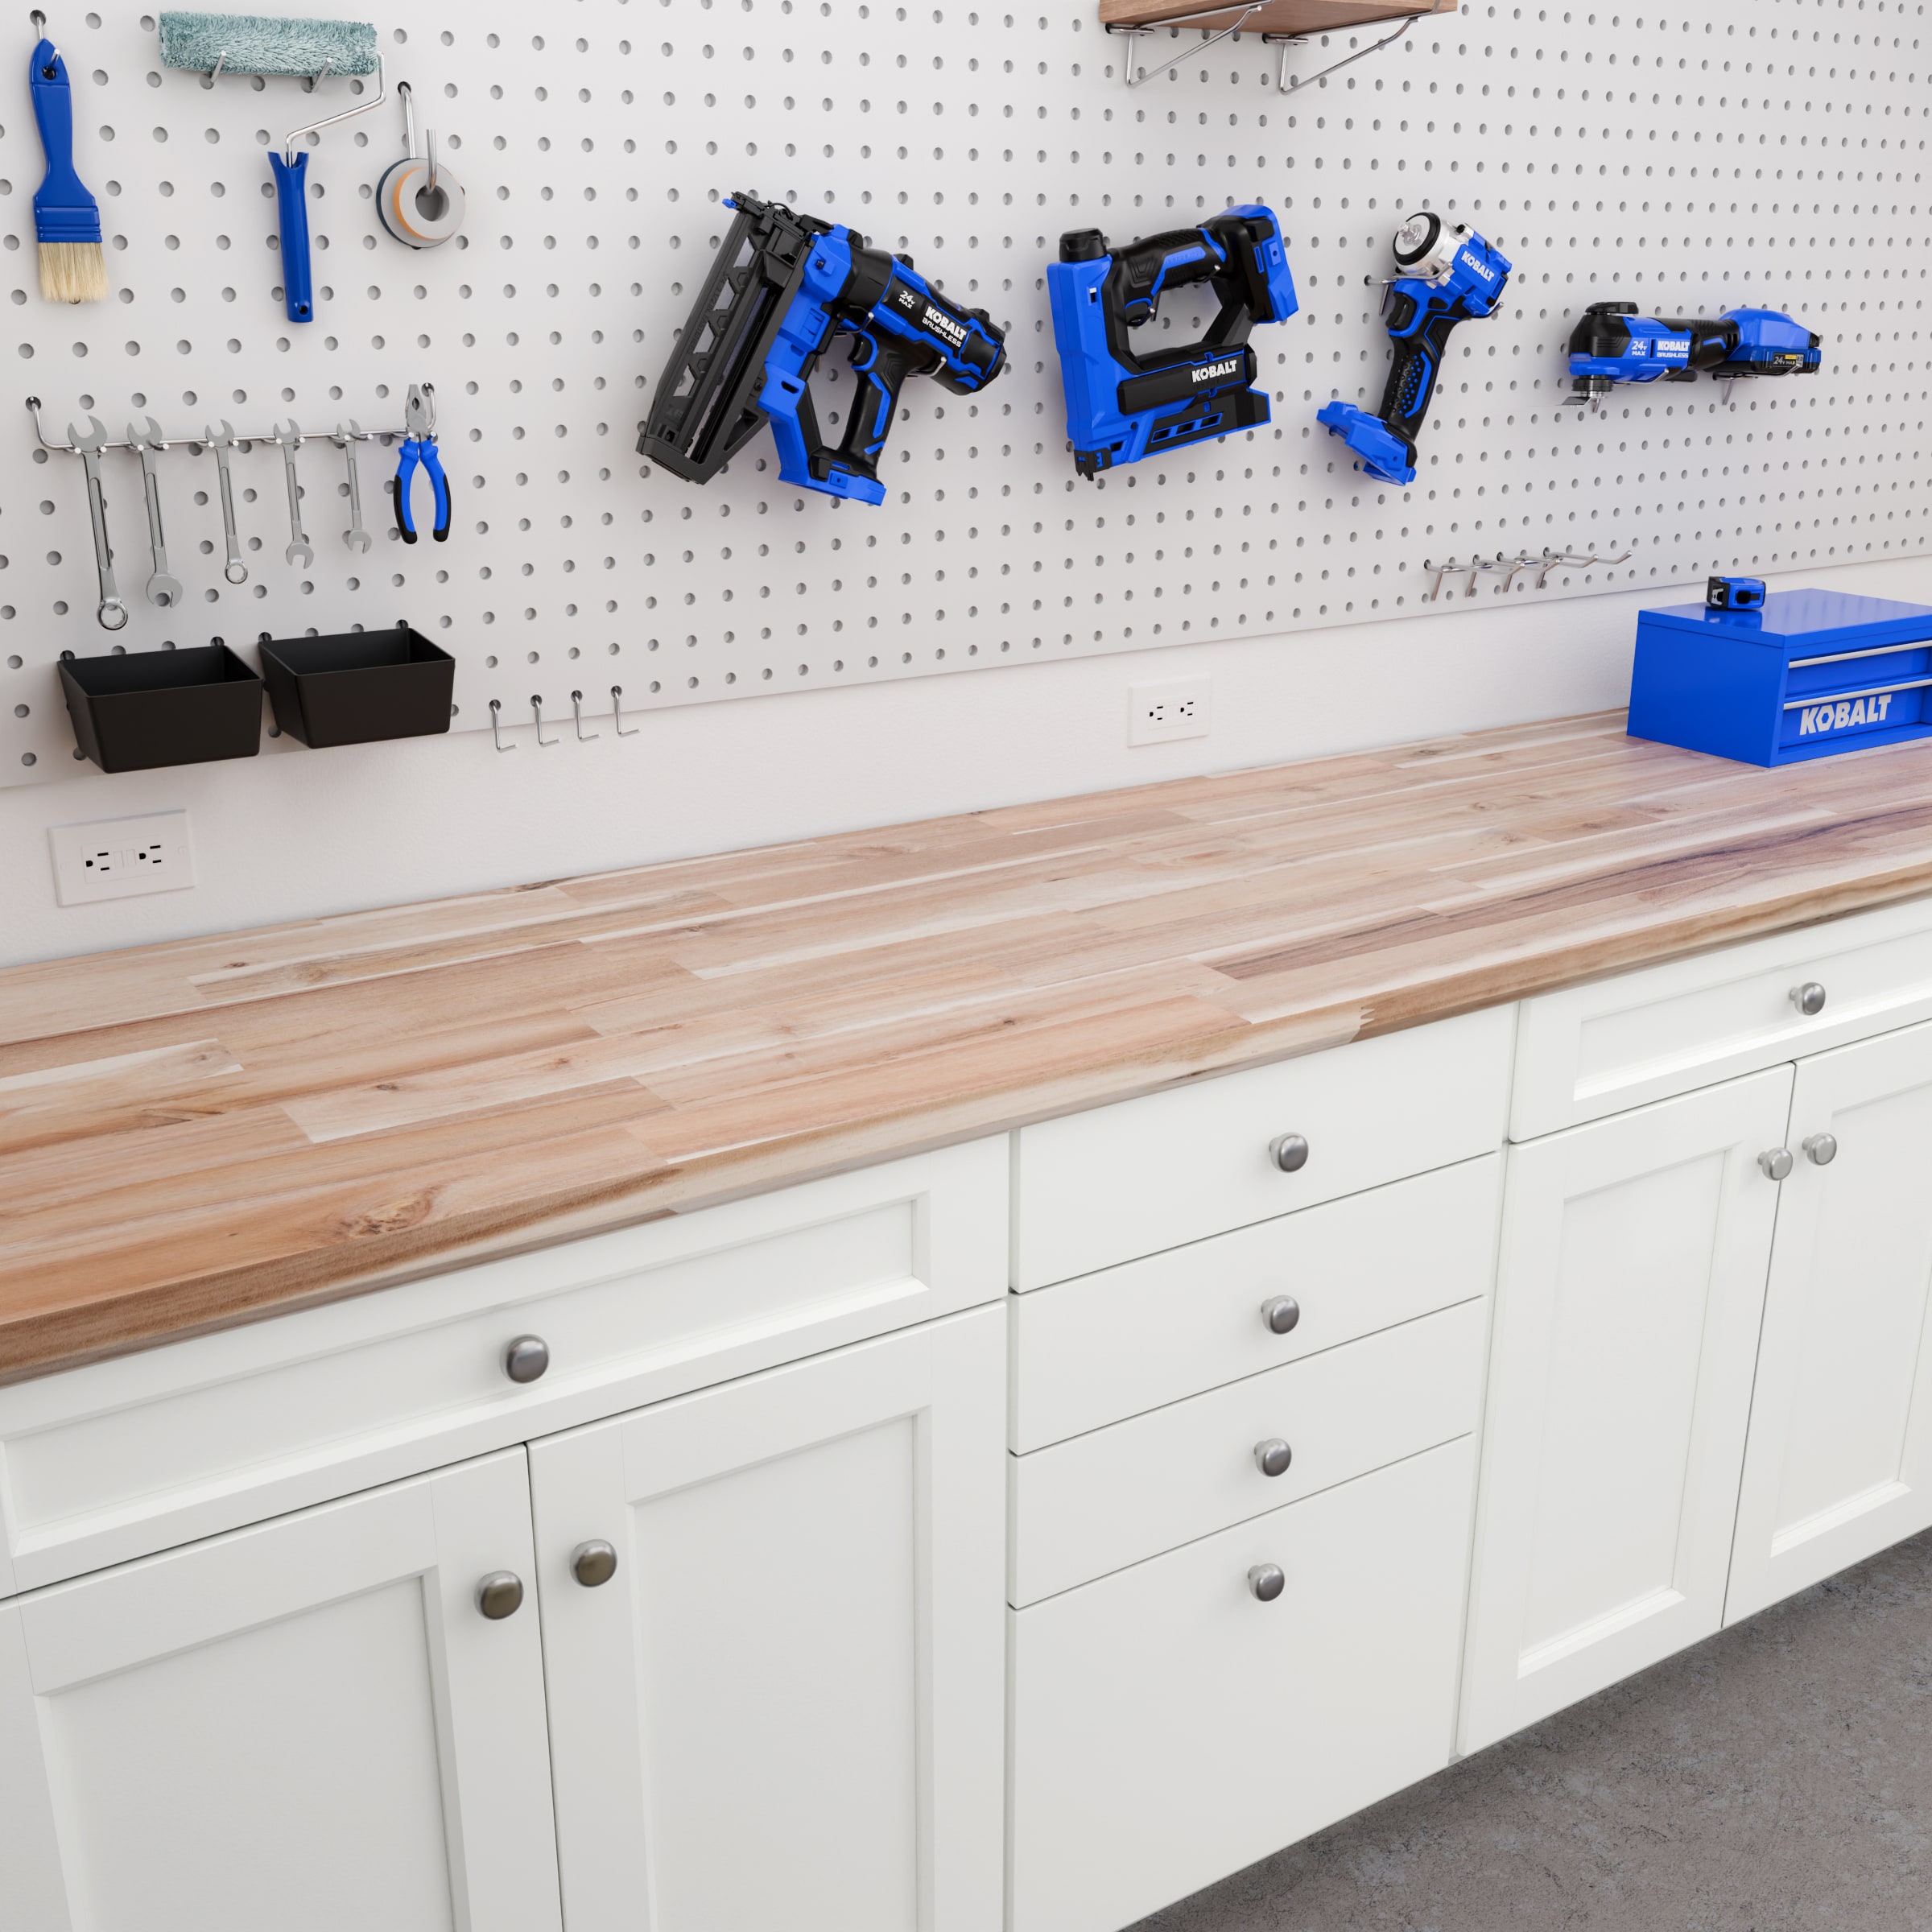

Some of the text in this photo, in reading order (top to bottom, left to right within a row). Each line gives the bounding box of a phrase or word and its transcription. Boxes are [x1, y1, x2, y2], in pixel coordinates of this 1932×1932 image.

[1461, 250, 1495, 282] KOBALT
[898, 297, 913, 309] MAX
[922, 316, 962, 348] BRUSHLESS
[925, 306, 967, 340] KOBALT
[1657, 341, 1690, 351] KOBALT
[1191, 360, 1237, 383] KOBALT
[1799, 694, 1892, 736] KOBALT
